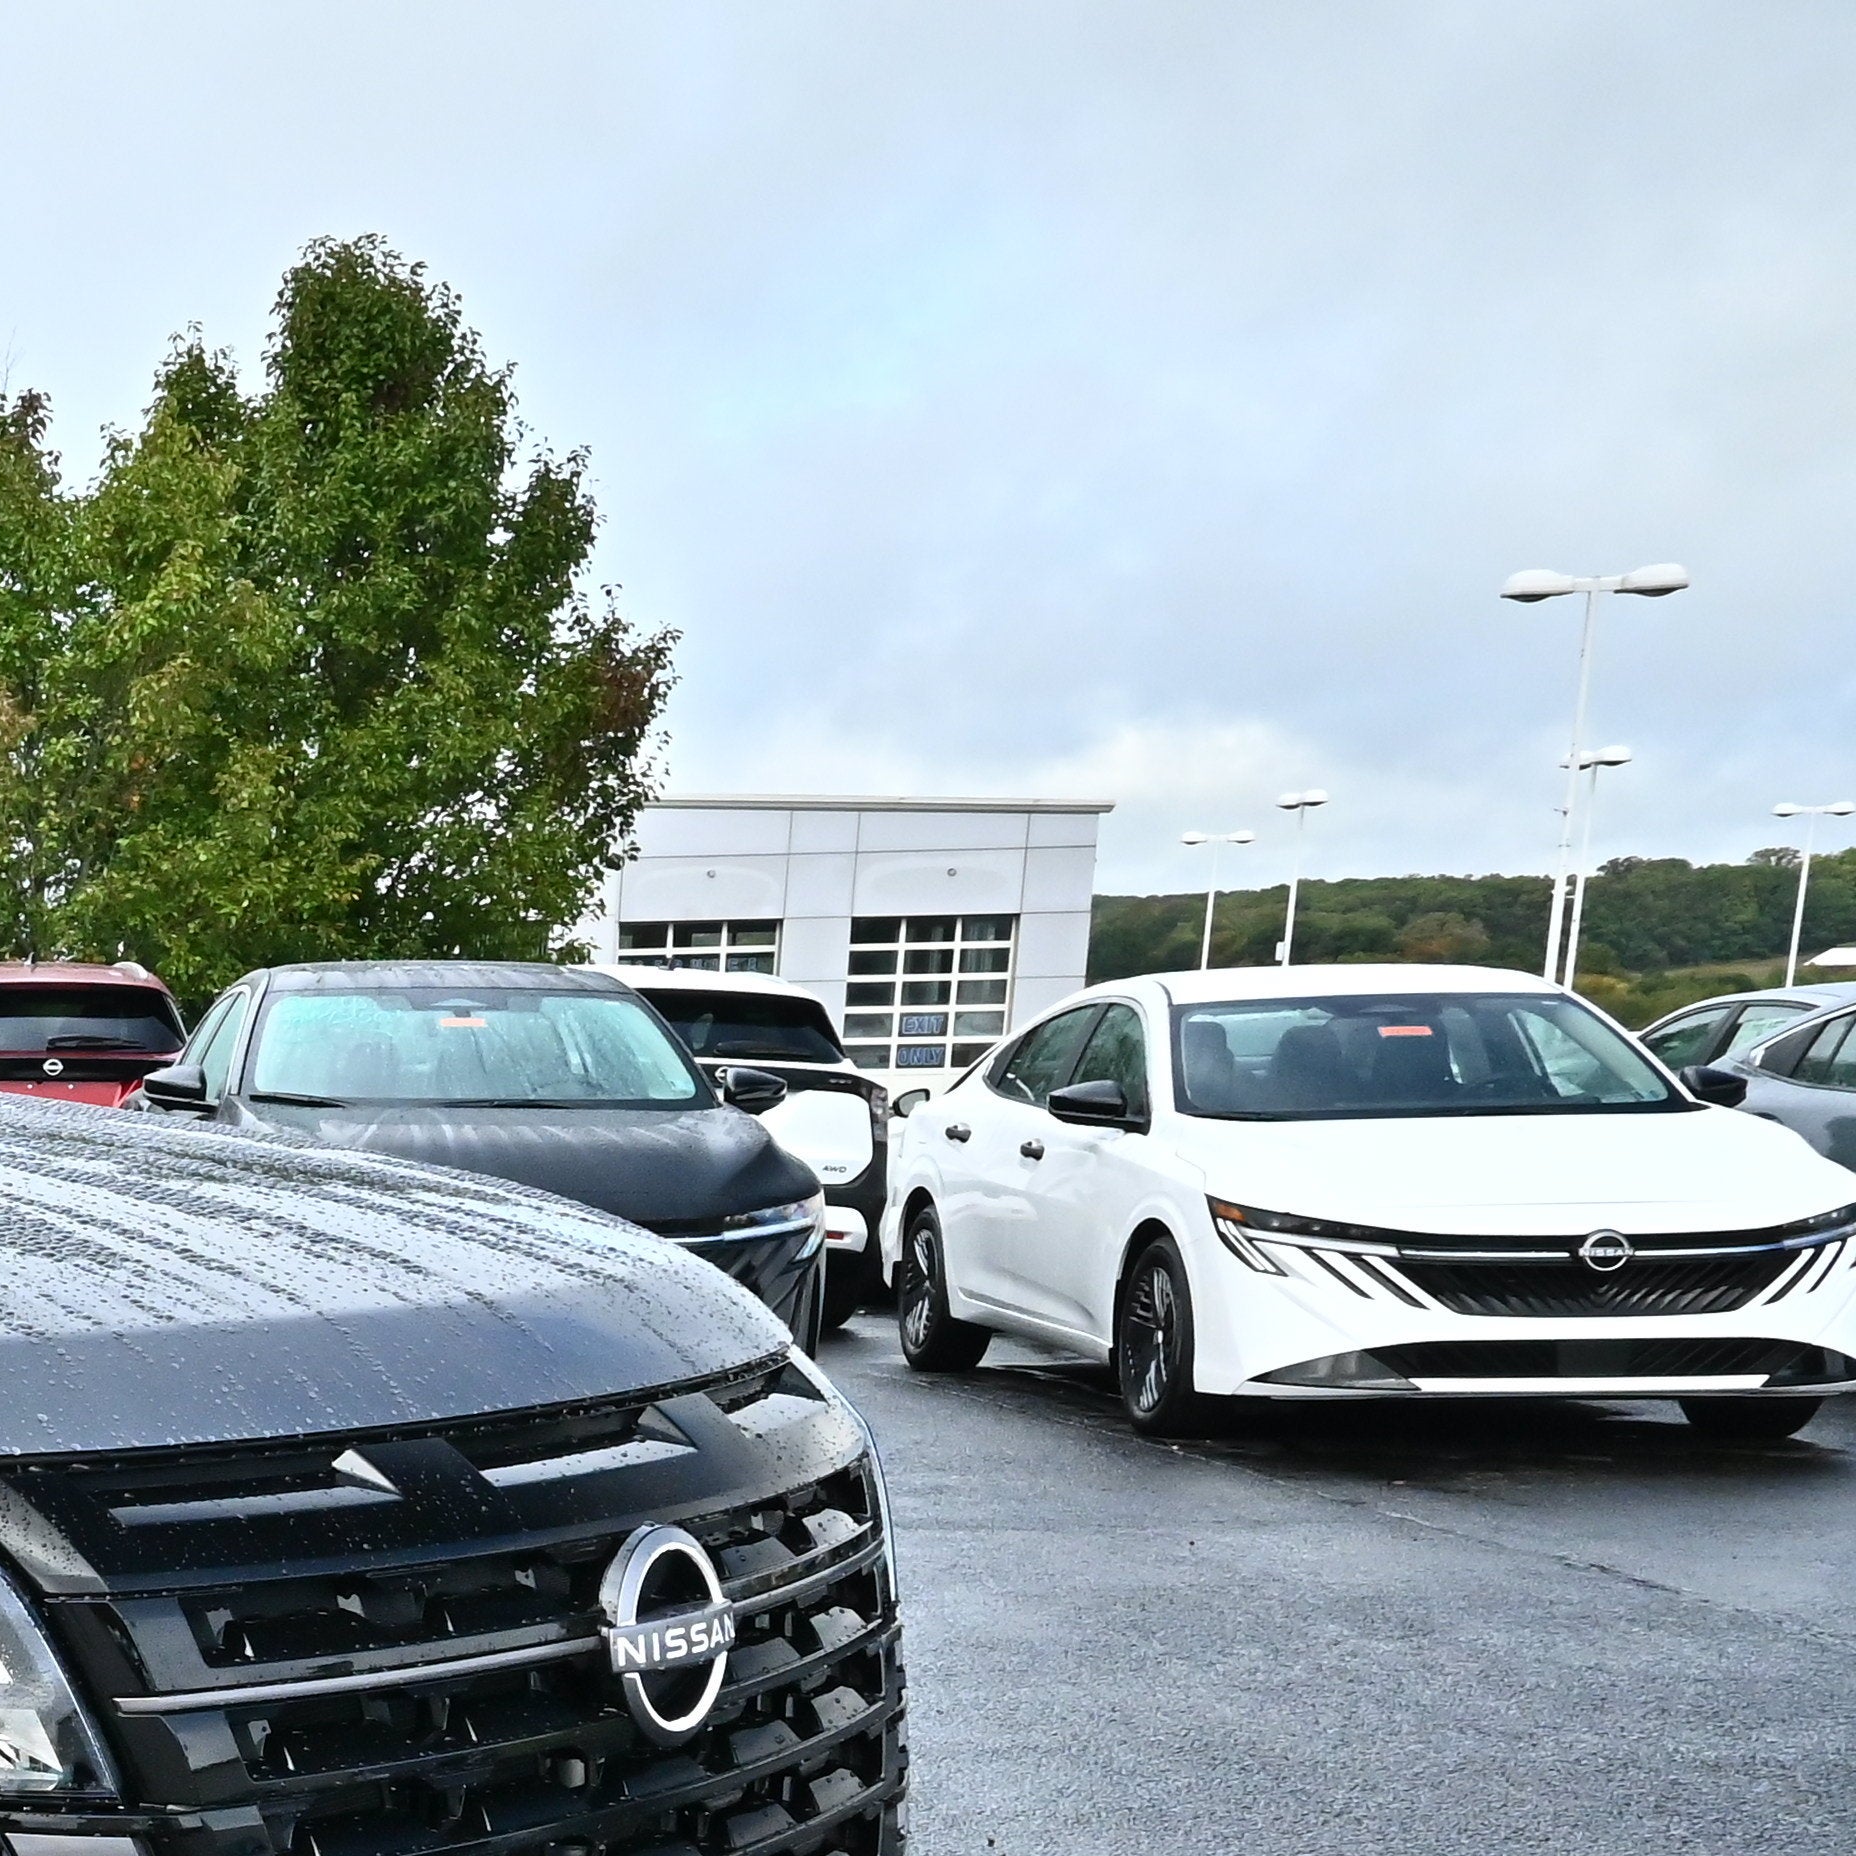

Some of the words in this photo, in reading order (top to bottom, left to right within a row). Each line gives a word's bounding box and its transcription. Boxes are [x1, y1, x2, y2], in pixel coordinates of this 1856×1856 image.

[902, 1015, 944, 1034] EXIT
[898, 1047, 944, 1066] ONLY
[822, 1165, 847, 1173] AWD
[1579, 1247, 1634, 1257] NISSAN
[617, 1611, 735, 1667] NISSAN
